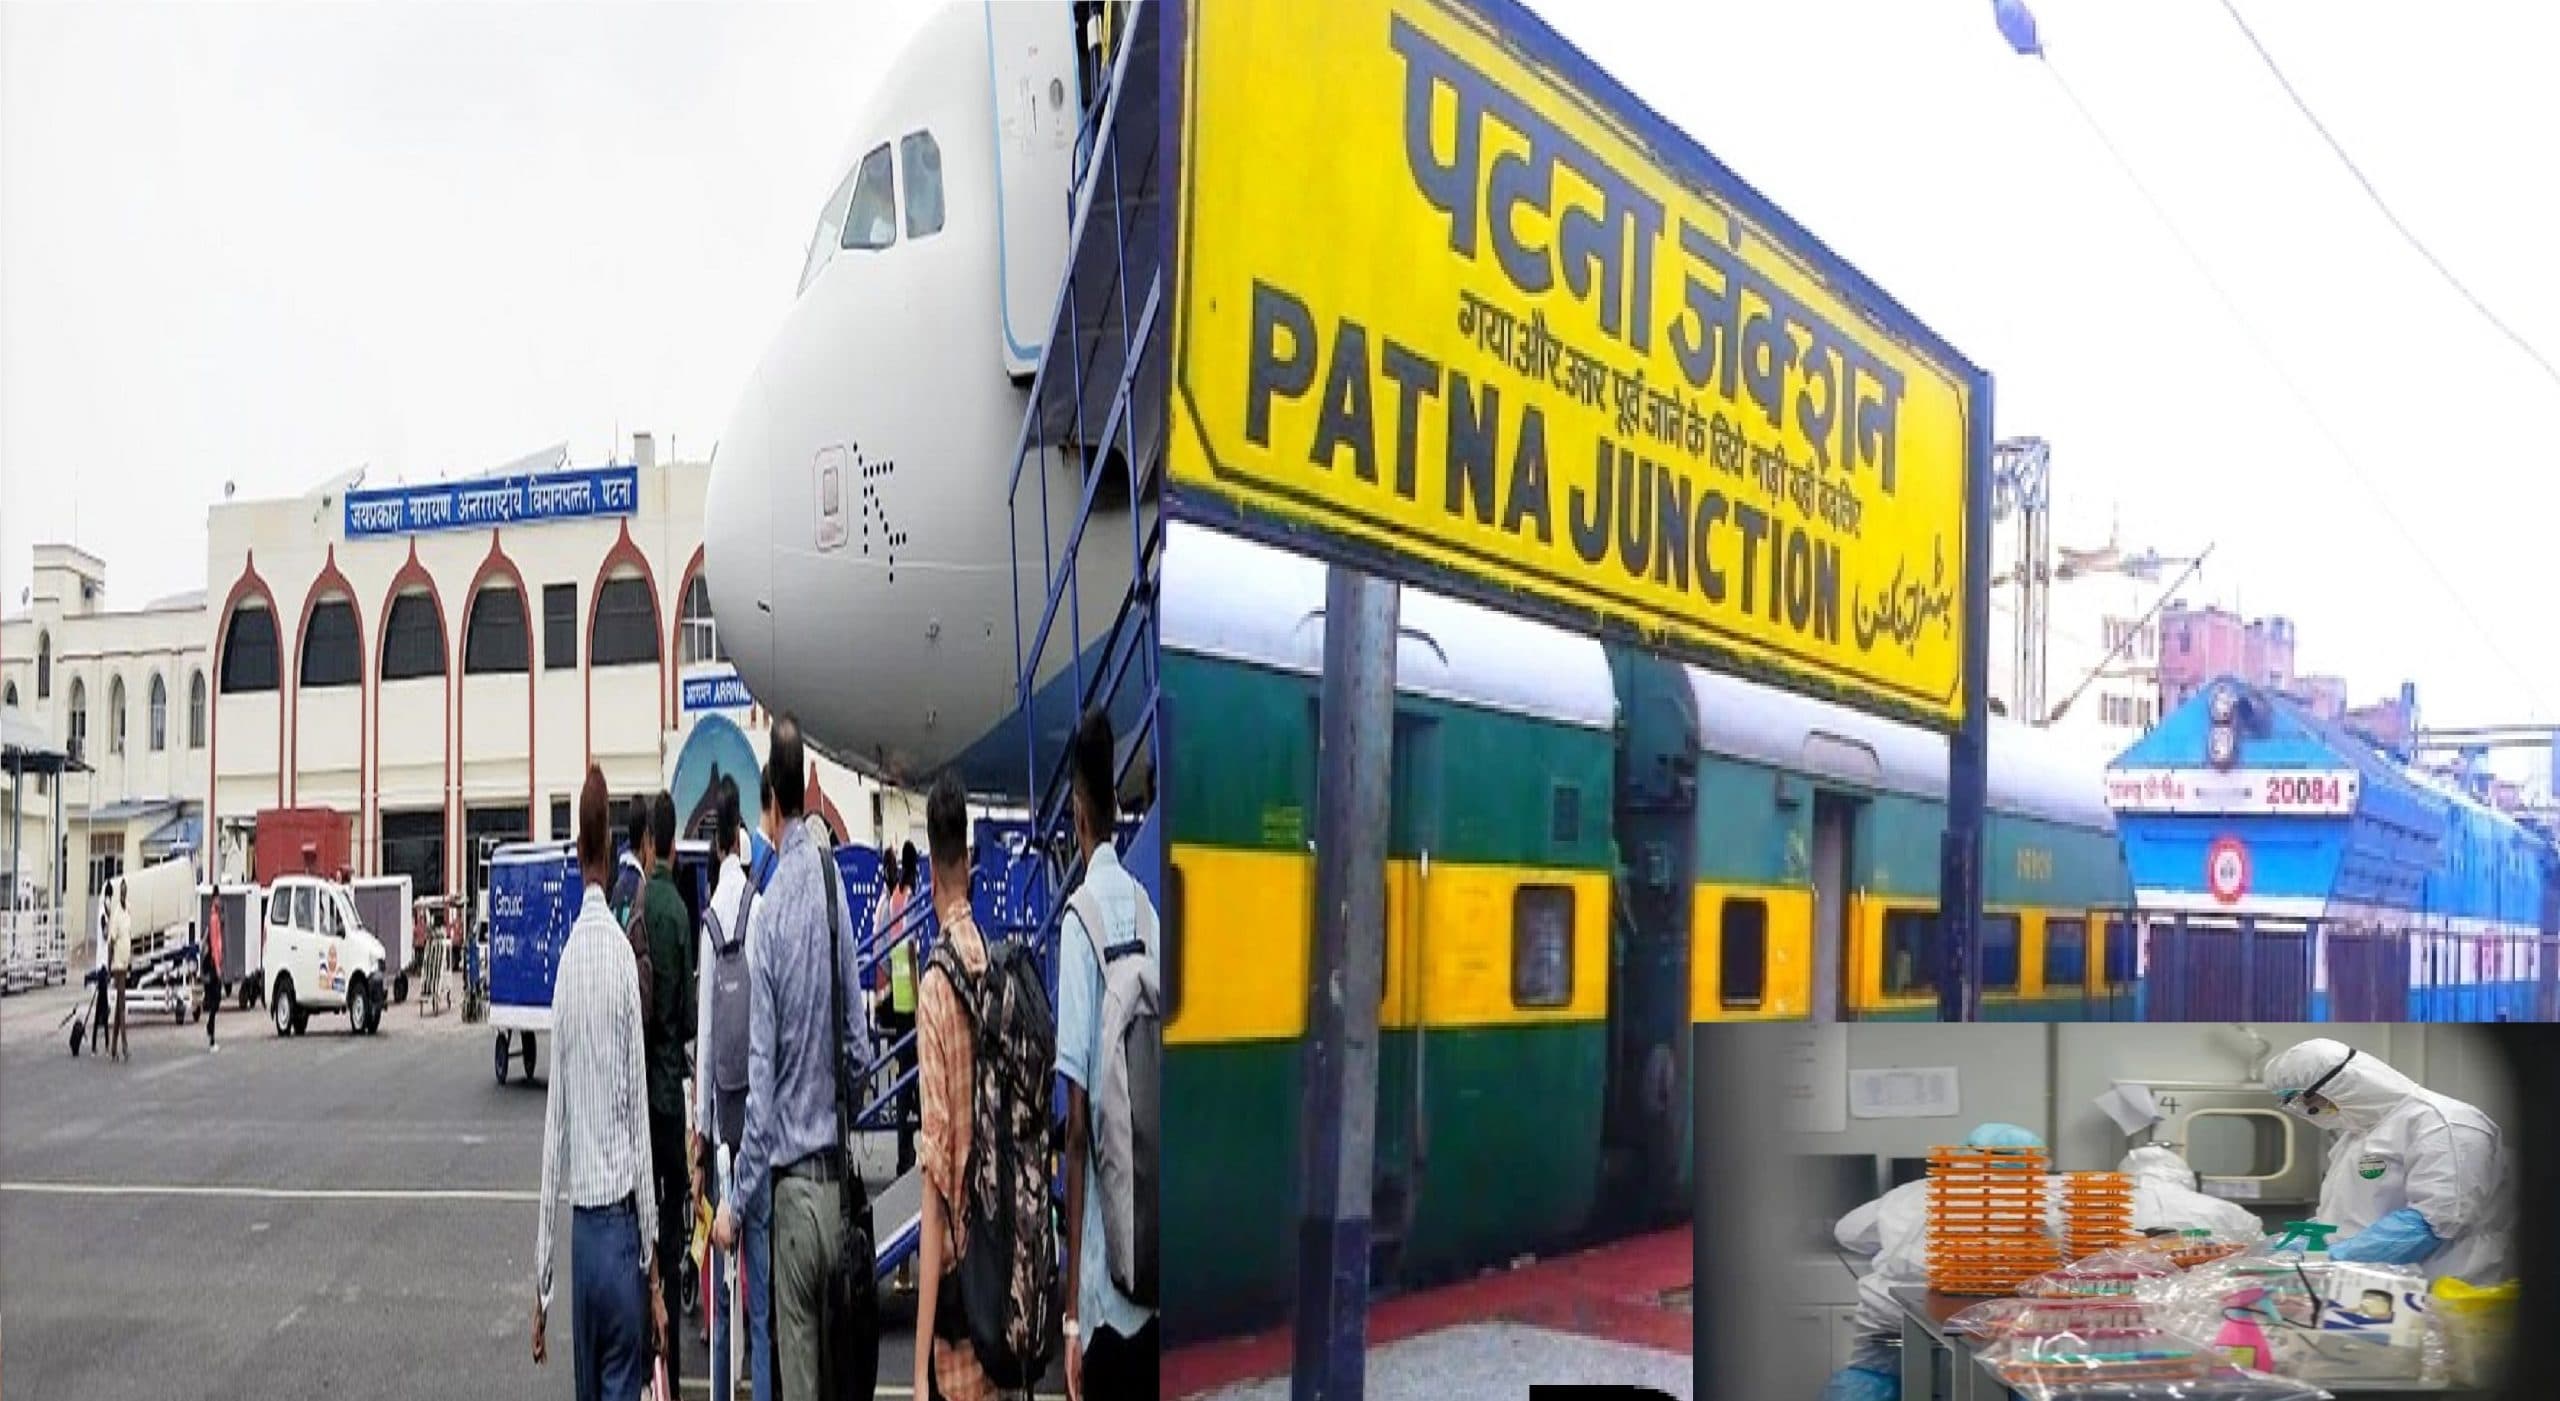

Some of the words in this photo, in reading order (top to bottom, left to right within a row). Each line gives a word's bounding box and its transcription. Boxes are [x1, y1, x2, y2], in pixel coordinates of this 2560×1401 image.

[1390, 9, 1666, 357] पटना
[1667, 215, 1906, 496] जंक्शन
[1458, 288, 1517, 369] गया
[1514, 307, 1564, 392] और
[1643, 386, 1686, 453] जाने
[1686, 398, 1708, 460] के
[350, 500, 404, 533] जयप्रकाश
[408, 495, 451, 527] नारायण
[601, 477, 632, 508] पटना
[1245, 278, 1553, 544] PATNA
[1569, 435, 1841, 646] JUNCTION
[2265, 775, 2341, 805] 20084
[494, 885, 523, 917] Ground
